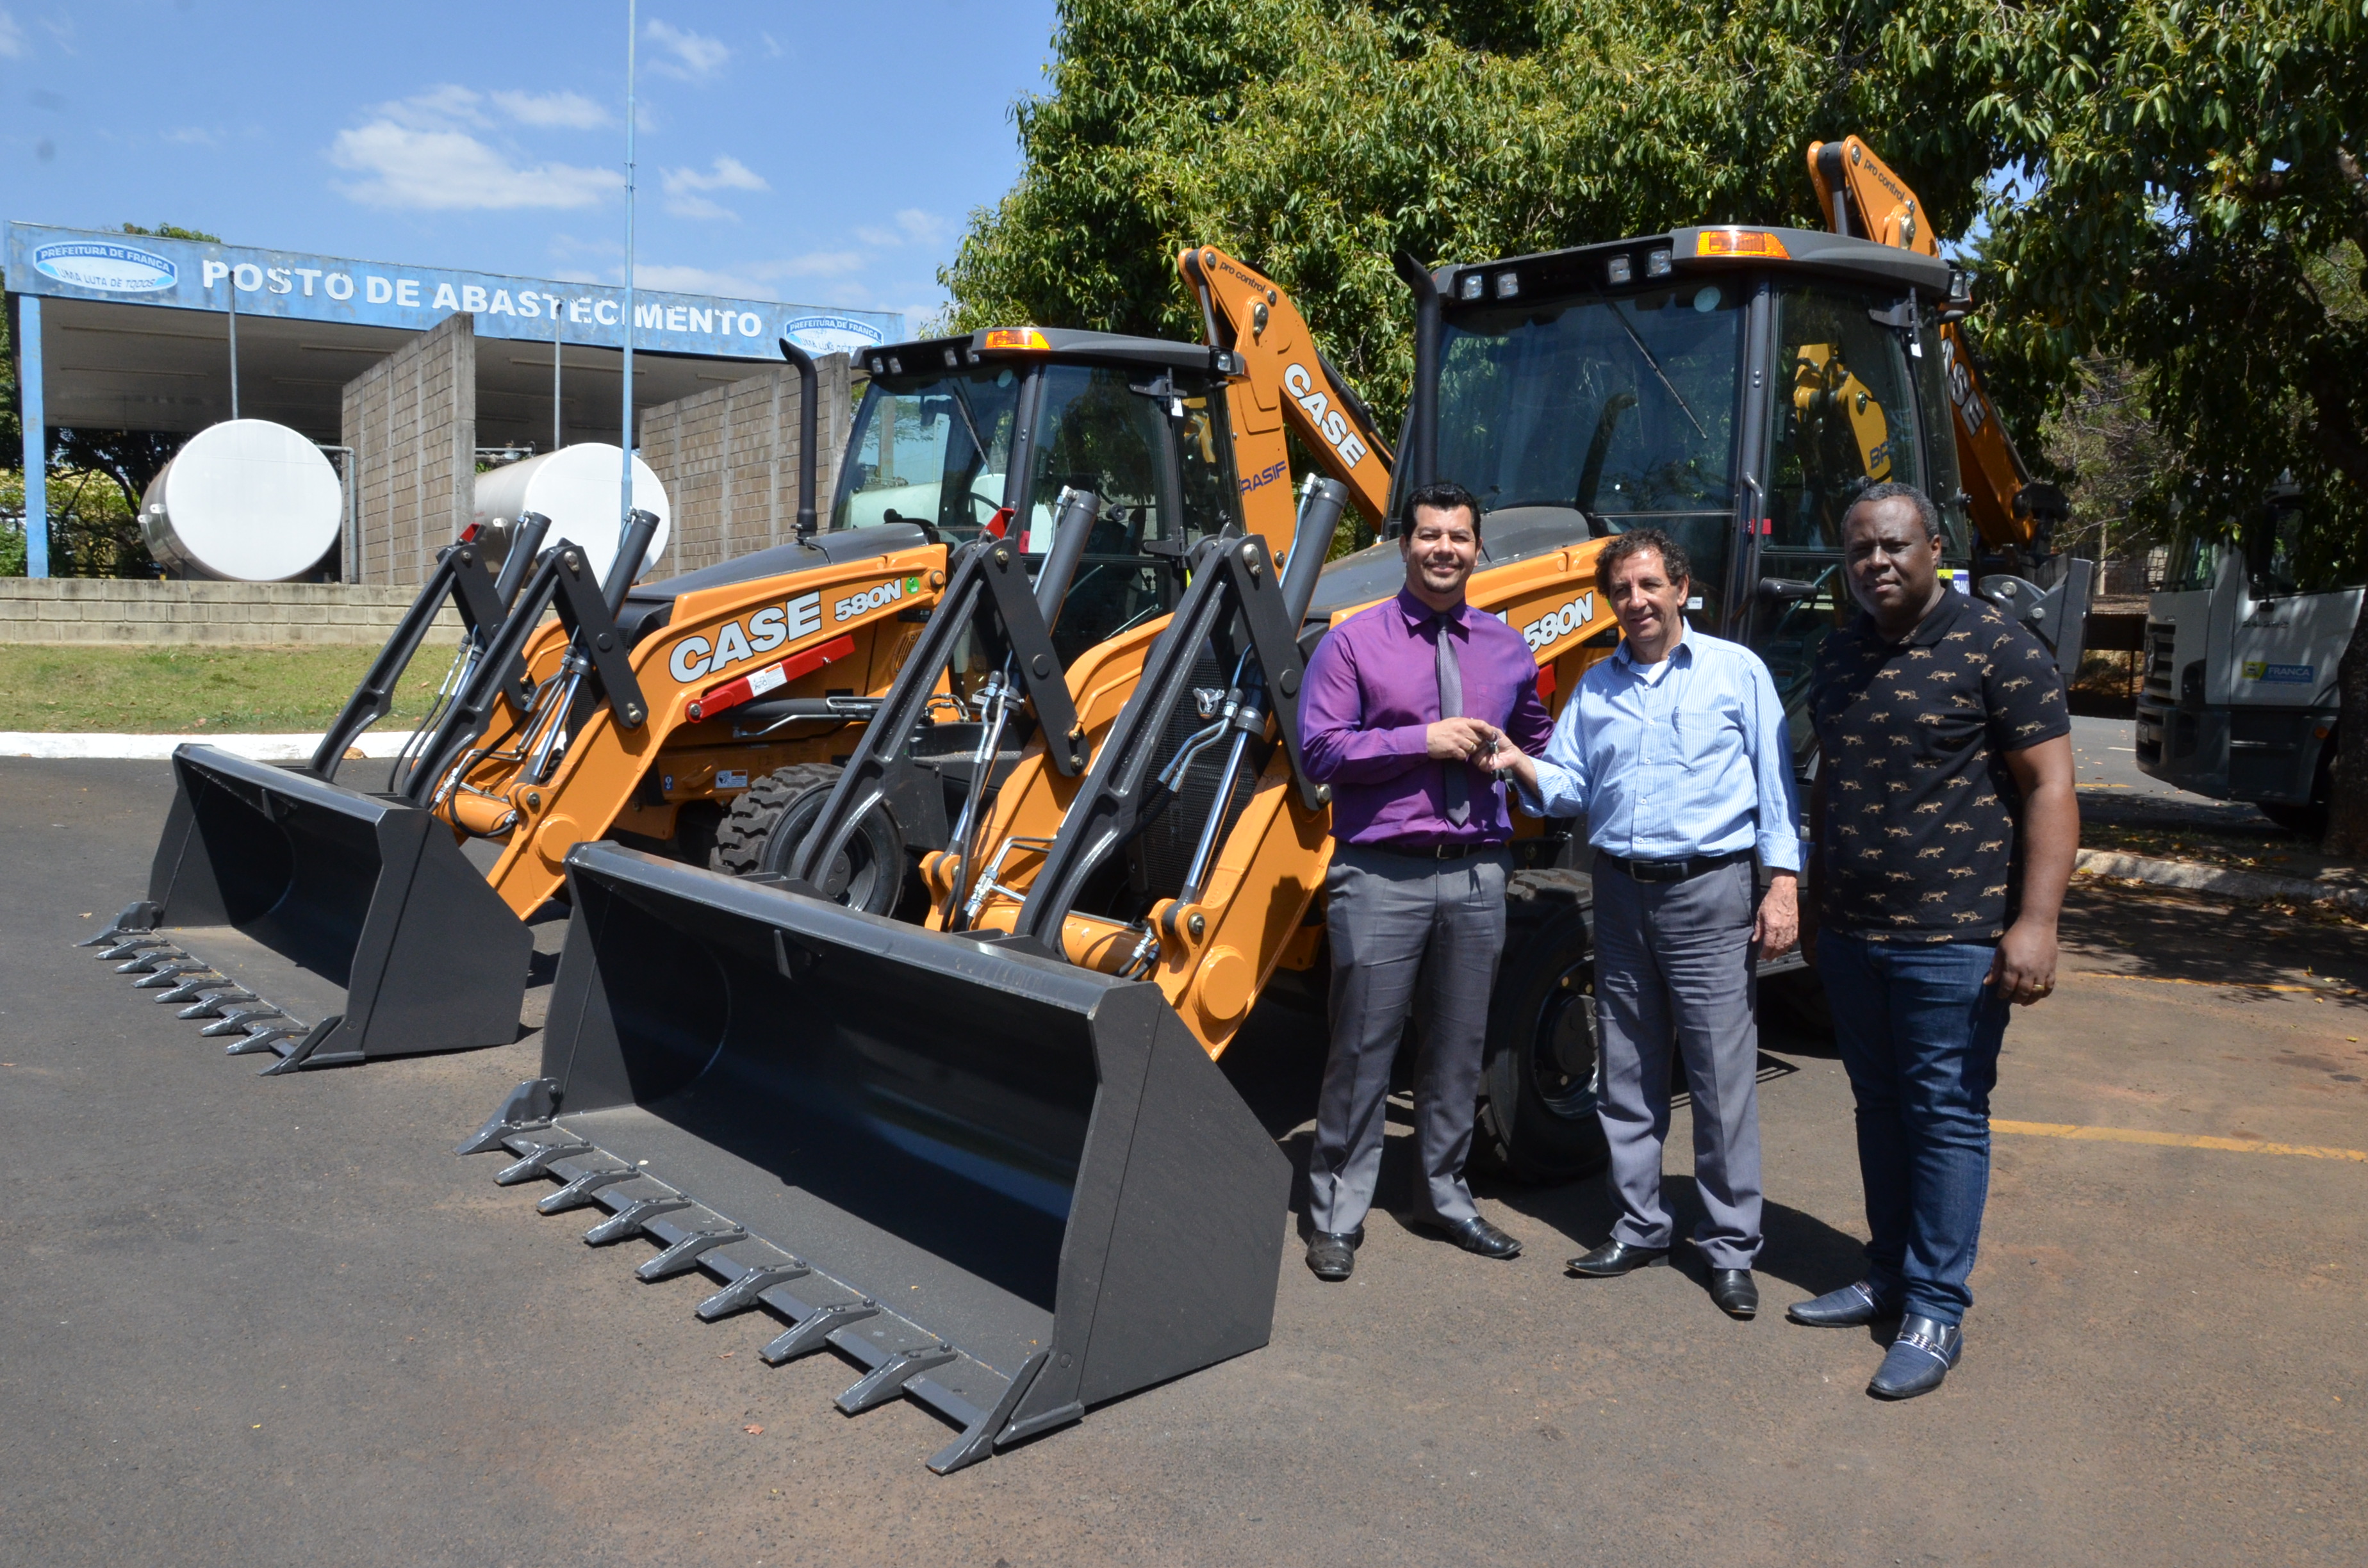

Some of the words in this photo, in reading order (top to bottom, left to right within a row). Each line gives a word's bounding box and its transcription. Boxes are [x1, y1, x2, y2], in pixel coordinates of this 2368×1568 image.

[1864, 159, 1878, 176] pro
[1878, 172, 1905, 202] control
[41, 246, 107, 259] PREFEITURA
[110, 248, 124, 258] DE
[127, 252, 170, 273] FRANCA
[1219, 261, 1235, 275] pro
[1235, 271, 1266, 293] control
[58, 268, 81, 281] UMA
[85, 275, 107, 286] LUTA
[111, 277, 122, 288] DE
[126, 279, 155, 290] TODOS
[203, 260, 354, 300] POSTO
[366, 275, 420, 307] DE
[790, 320, 835, 331] PREFEITURA
[837, 321, 847, 329] DE
[849, 322, 878, 339] FRANCA
[1284, 363, 1367, 470] CASE
[1240, 460, 1287, 496] RASIF
[669, 590, 822, 683] CASE
[834, 578, 901, 622] 580N
[1523, 591, 1593, 653] 580N
[2268, 666, 2310, 676] FRANCA
